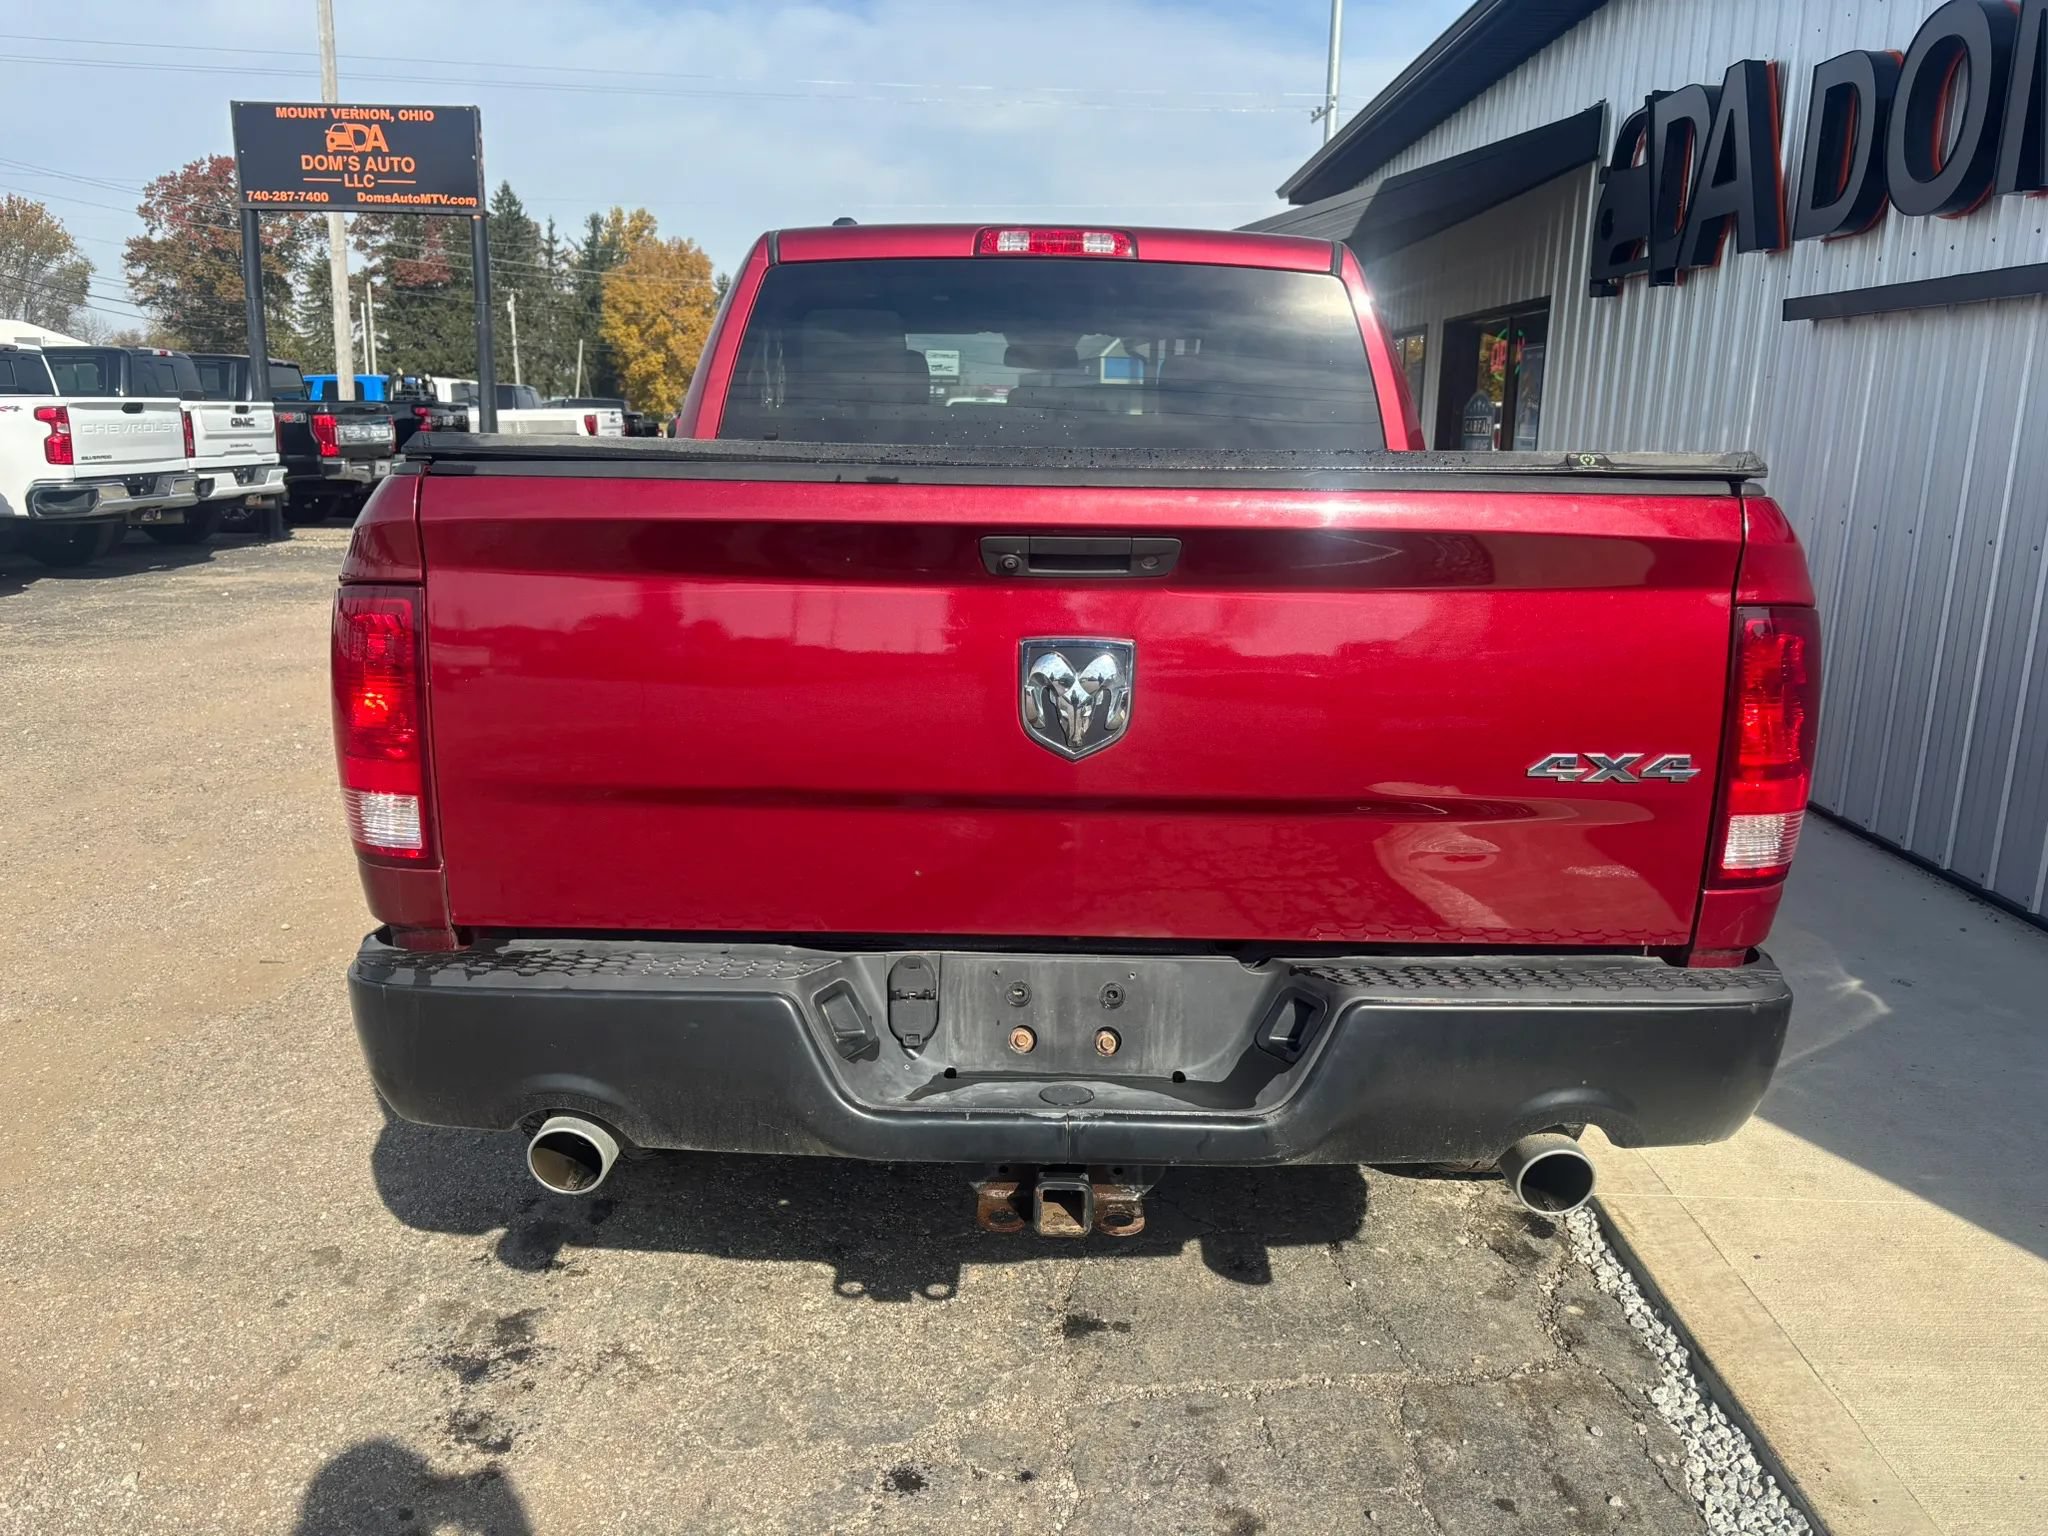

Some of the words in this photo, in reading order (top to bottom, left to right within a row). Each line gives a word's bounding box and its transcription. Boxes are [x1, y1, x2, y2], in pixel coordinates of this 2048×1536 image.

[275, 107, 327, 120] MOUNT
[331, 108, 395, 122] VERNON,
[398, 109, 435, 121] OHIO
[301, 154, 361, 172] DOM'S
[365, 156, 416, 173] AUTO
[343, 173, 375, 188] LLC
[246, 190, 329, 203] 740-287-7400
[357, 192, 477, 207] DomsAutoMTV.com
[80, 423, 180, 435] CHEVROLET
[230, 417, 256, 428] GMC
[1526, 752, 1702, 783] 4X4
